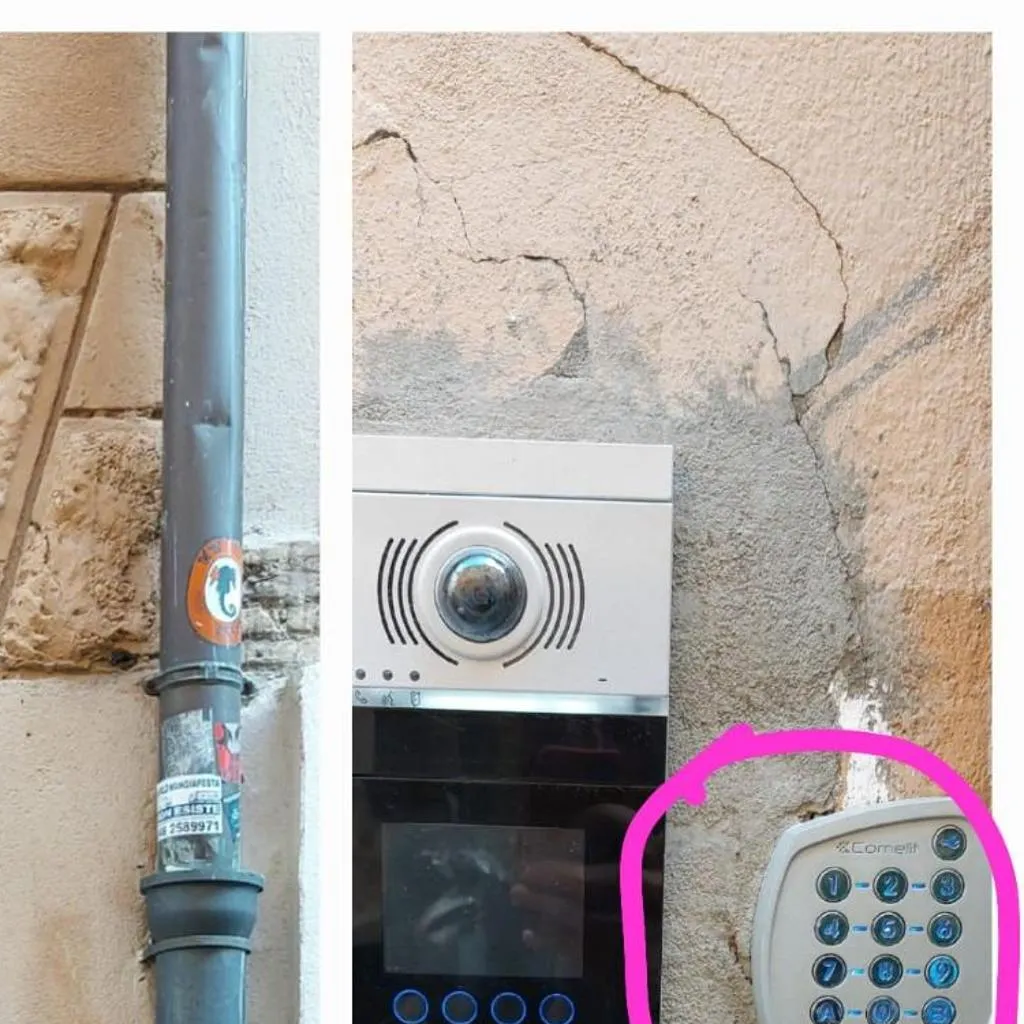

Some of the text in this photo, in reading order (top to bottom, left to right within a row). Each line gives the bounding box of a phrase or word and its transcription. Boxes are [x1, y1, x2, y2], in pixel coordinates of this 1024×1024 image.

[852, 842, 920, 854] Comelit
[883, 872, 900, 896] 2
[939, 873, 956, 896] 3
[880, 917, 897, 940] 5
[822, 958, 838, 982] 7
